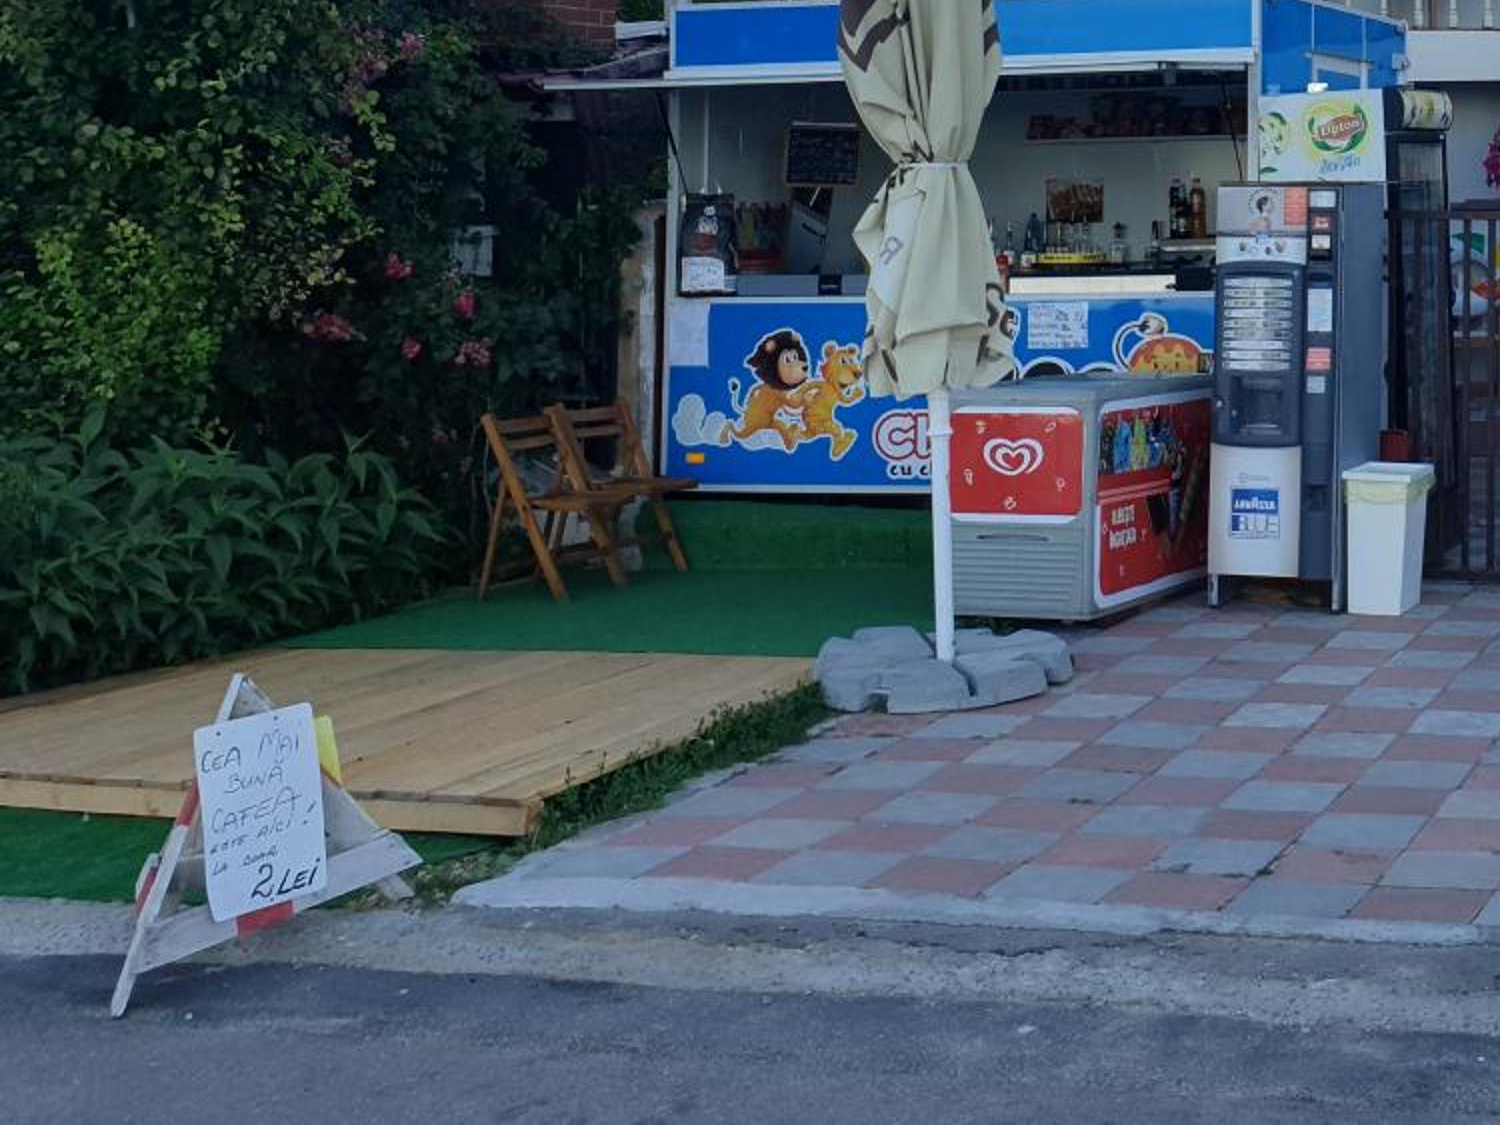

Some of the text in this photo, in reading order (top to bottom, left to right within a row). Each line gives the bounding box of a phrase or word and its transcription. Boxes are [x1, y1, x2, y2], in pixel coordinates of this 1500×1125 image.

[1320, 119, 1360, 138] Lipton
[201, 728, 299, 774] CEA MAI
[211, 786, 302, 834] CAFEA
[276, 857, 321, 896] LEI
